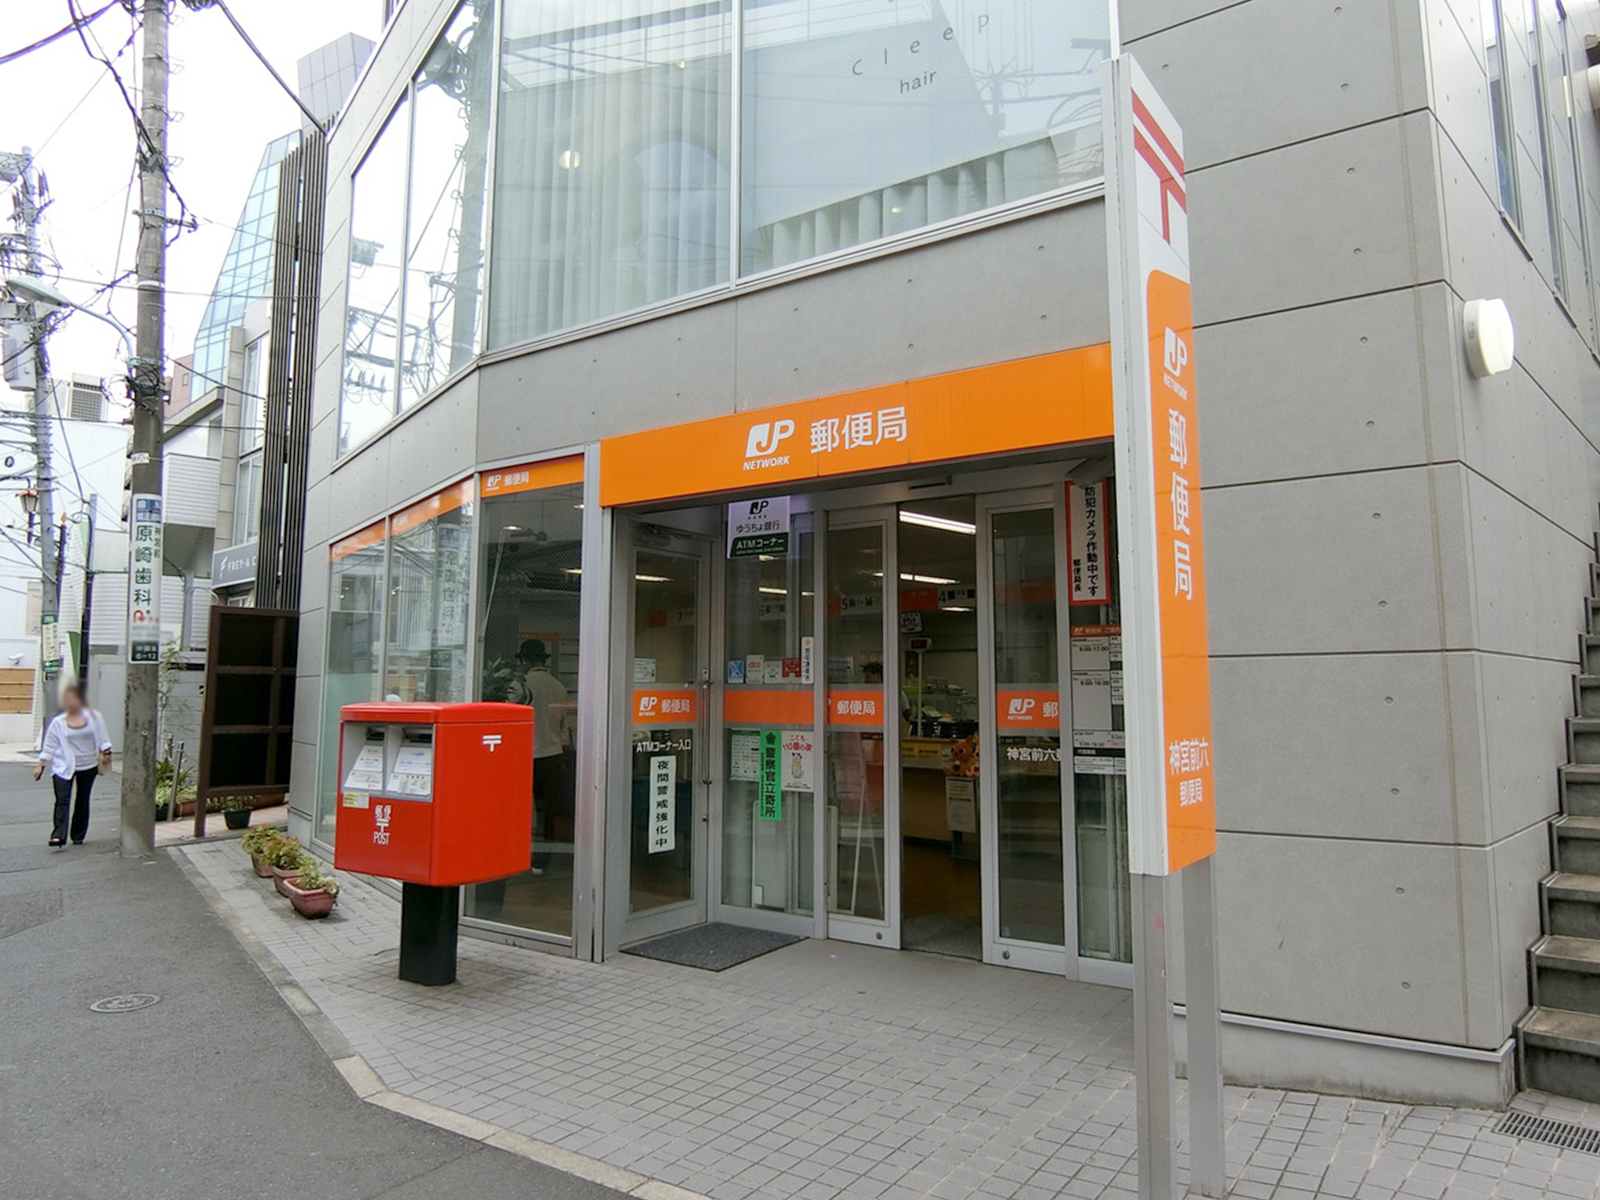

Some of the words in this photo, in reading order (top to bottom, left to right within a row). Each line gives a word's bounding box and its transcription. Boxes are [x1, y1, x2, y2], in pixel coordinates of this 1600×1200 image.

[899, 70, 938, 95] hair
[1163, 326, 1188, 377] JP
[745, 418, 796, 458] JP
[810, 406, 908, 454] 郵便局
[742, 455, 791, 471] NETWORK
[486, 474, 502, 487] JP
[749, 500, 769, 515] JP
[1168, 407, 1193, 601] 郵便局
[735, 520, 780, 534] ゆうちょ銀行
[736, 537, 785, 550] ATMコーナー
[1085, 486, 1099, 597] 防犯カメラ作動中です
[639, 696, 658, 711] JP
[661, 698, 691, 713] 郵便局
[836, 700, 876, 716] 郵便局
[1008, 698, 1036, 714] JP
[636, 739, 692, 753] ATMコーナー入口
[1168, 736, 1210, 776] 神宮前六
[655, 760, 670, 848] 夜間警戒強化中
[373, 831, 391, 846] POST
